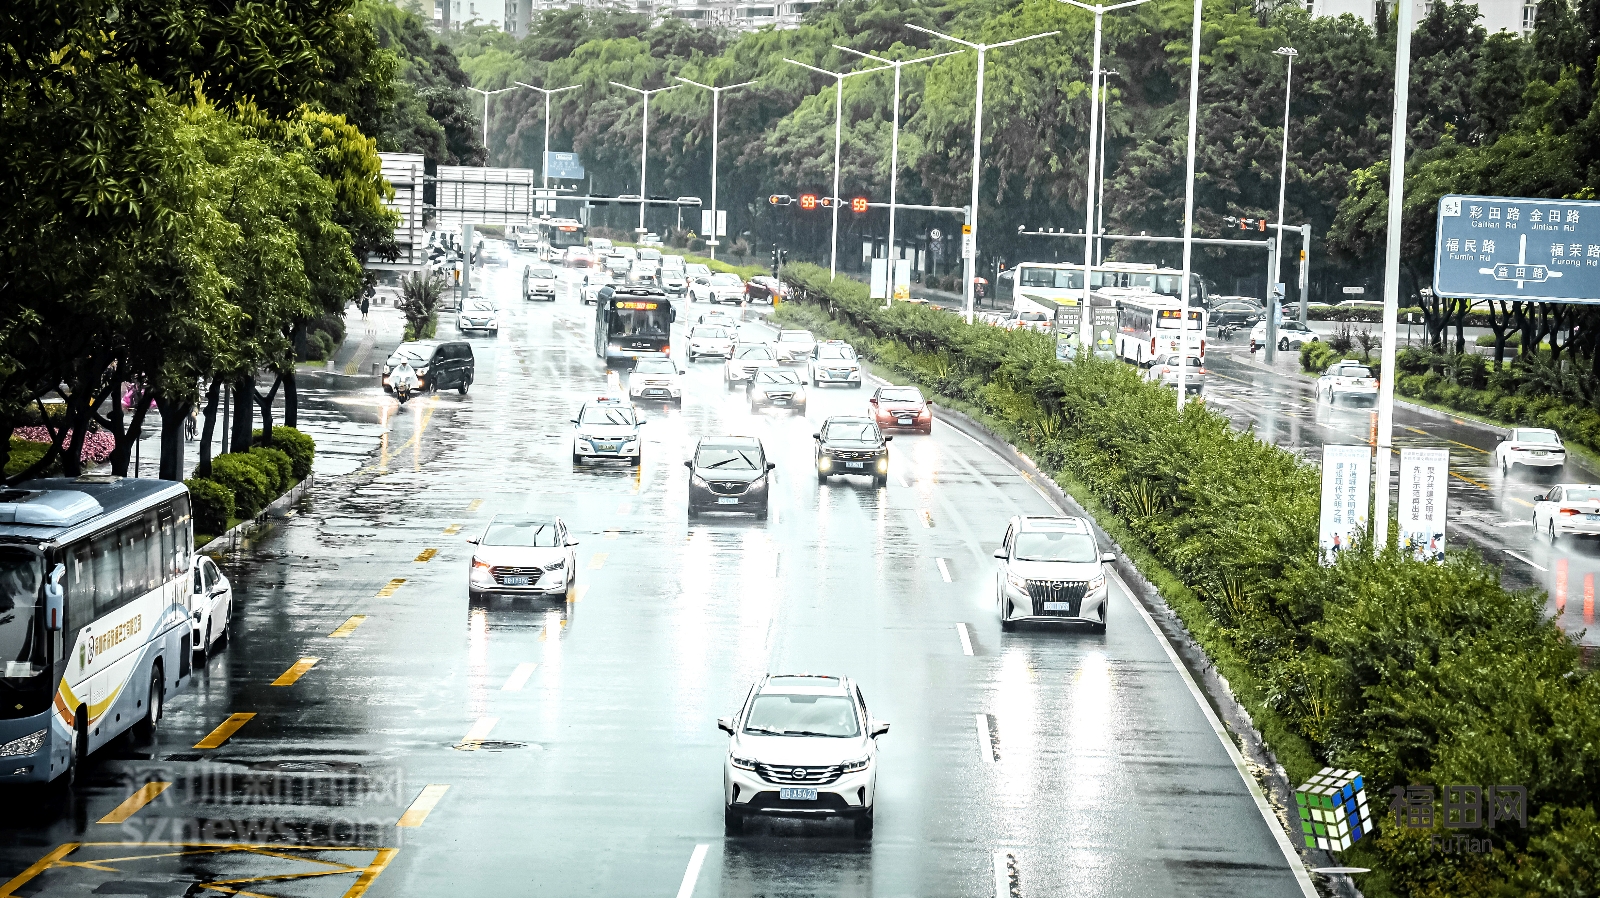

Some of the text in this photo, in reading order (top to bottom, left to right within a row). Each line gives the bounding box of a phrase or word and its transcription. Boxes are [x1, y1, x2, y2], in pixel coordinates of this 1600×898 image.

[802, 195, 815, 208] 59
[853, 198, 867, 211] 59
[1469, 205, 1581, 224] 彩田路 金田路
[1471, 220, 1575, 232] Caitian Rd Jintian Rd
[1445, 238, 1496, 254] 福民路
[1550, 242, 1600, 258] 福荣路
[1449, 252, 1491, 262] Fumin Rd
[1551, 257, 1598, 267] Furong Rd
[1497, 267, 1544, 279] 益田路
